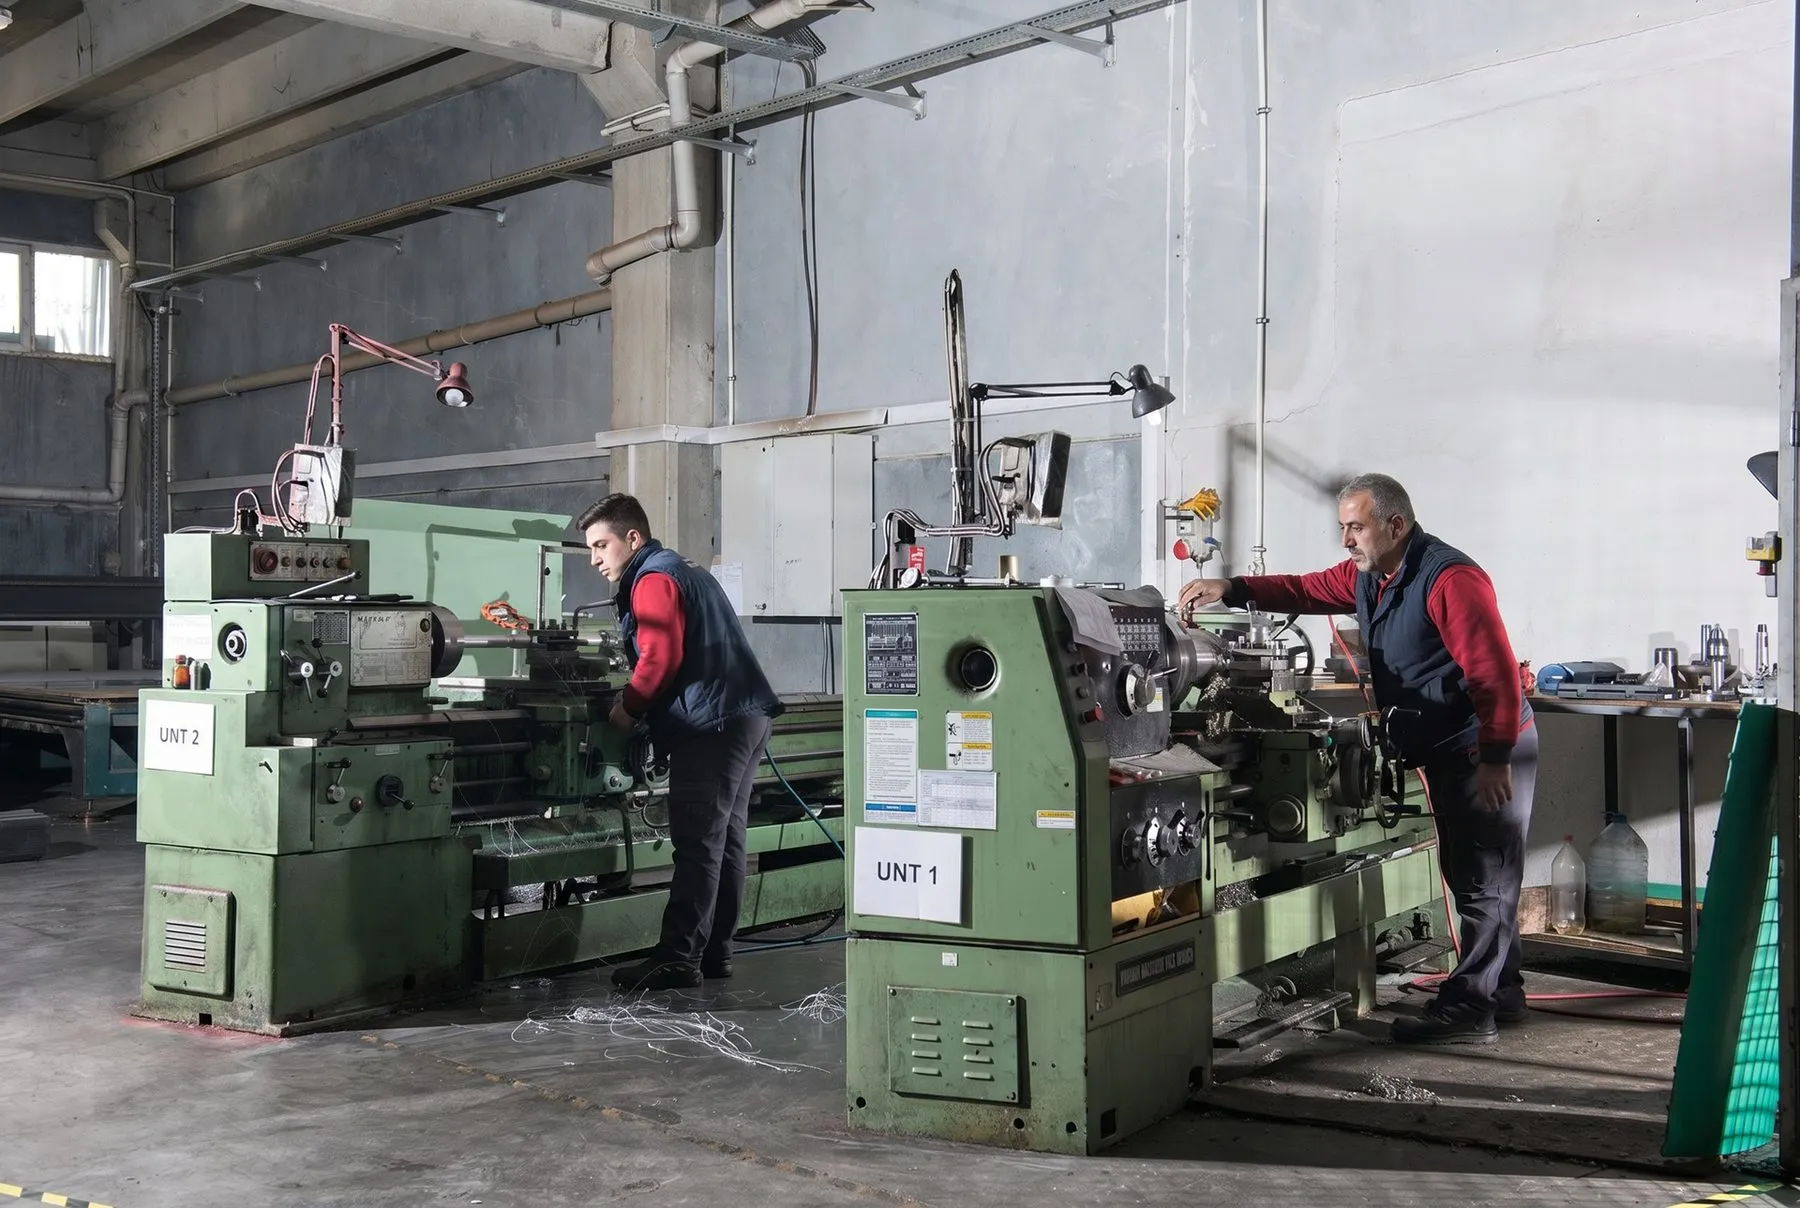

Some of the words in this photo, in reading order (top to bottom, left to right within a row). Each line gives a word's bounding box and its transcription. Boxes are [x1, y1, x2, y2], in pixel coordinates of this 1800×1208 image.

[160, 727, 188, 744] UNT
[192, 729, 199, 745] 2
[877, 861, 922, 883] UNT
[928, 865, 937, 885] 1
